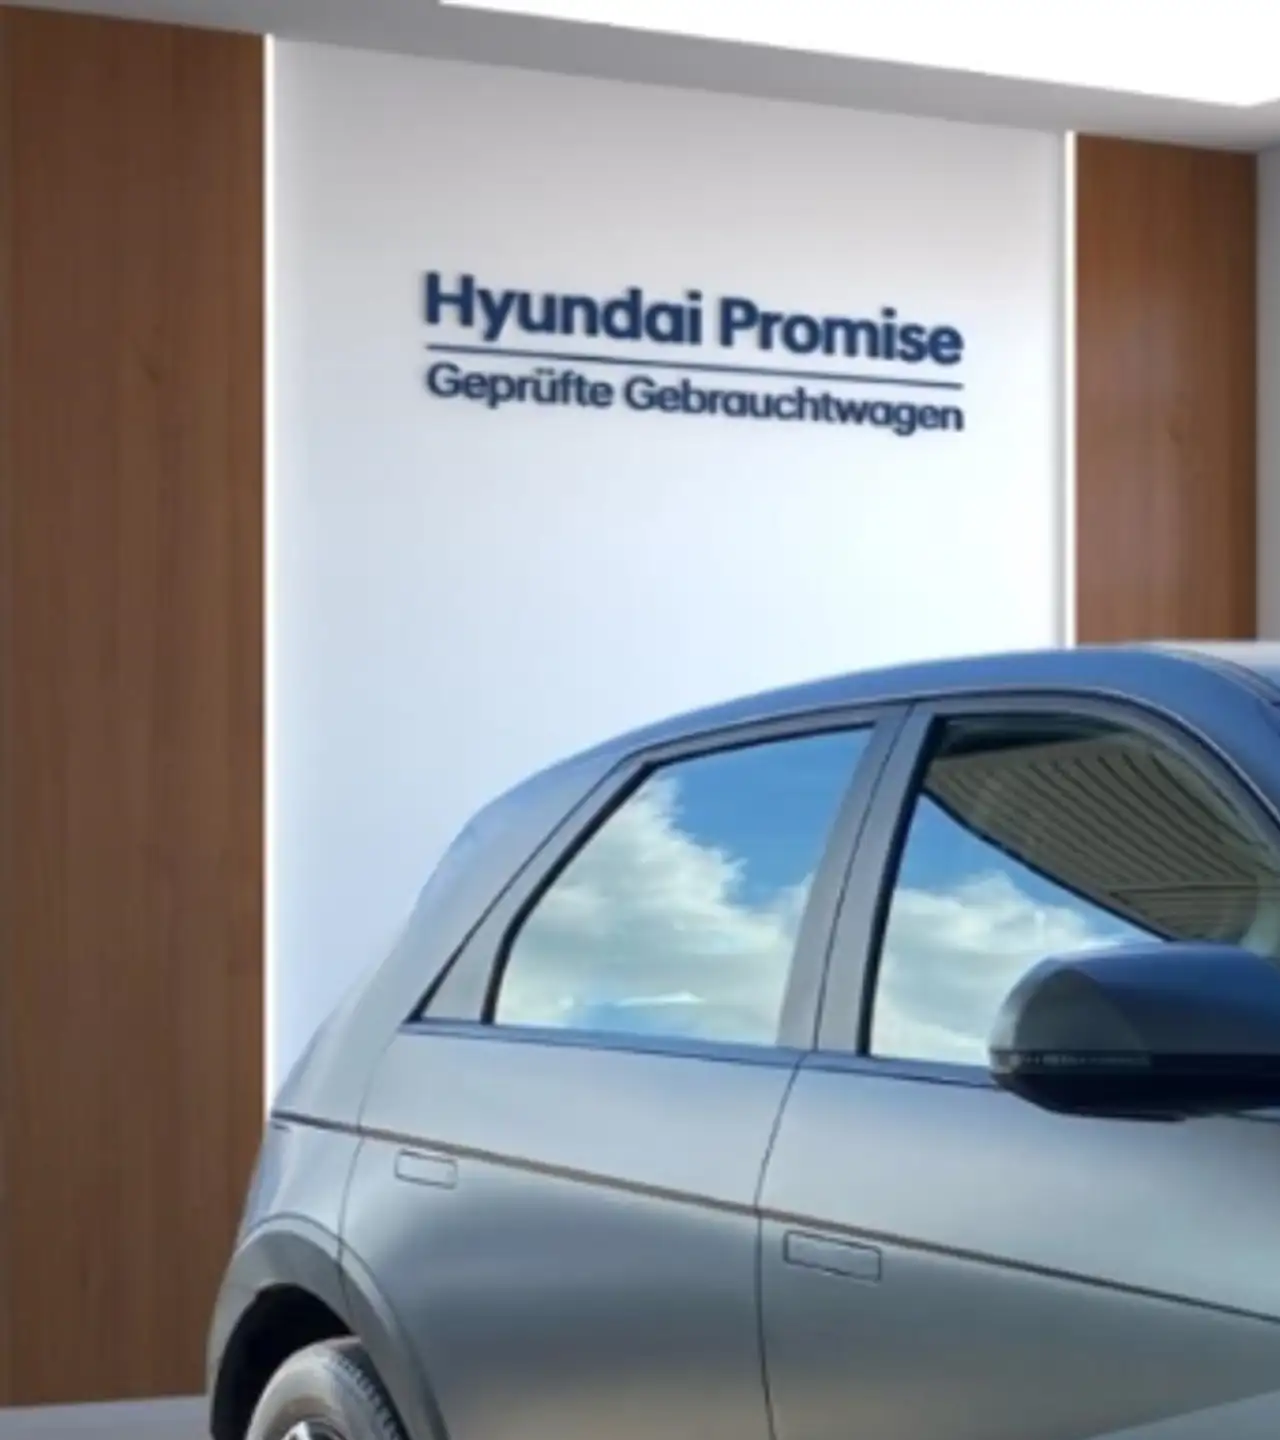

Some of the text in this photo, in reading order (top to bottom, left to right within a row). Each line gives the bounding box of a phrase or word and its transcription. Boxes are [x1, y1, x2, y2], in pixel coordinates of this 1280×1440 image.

[422, 271, 965, 366] Hyundai Promise
[426, 361, 965, 436] Geprüfte Gebrauchtwagen
